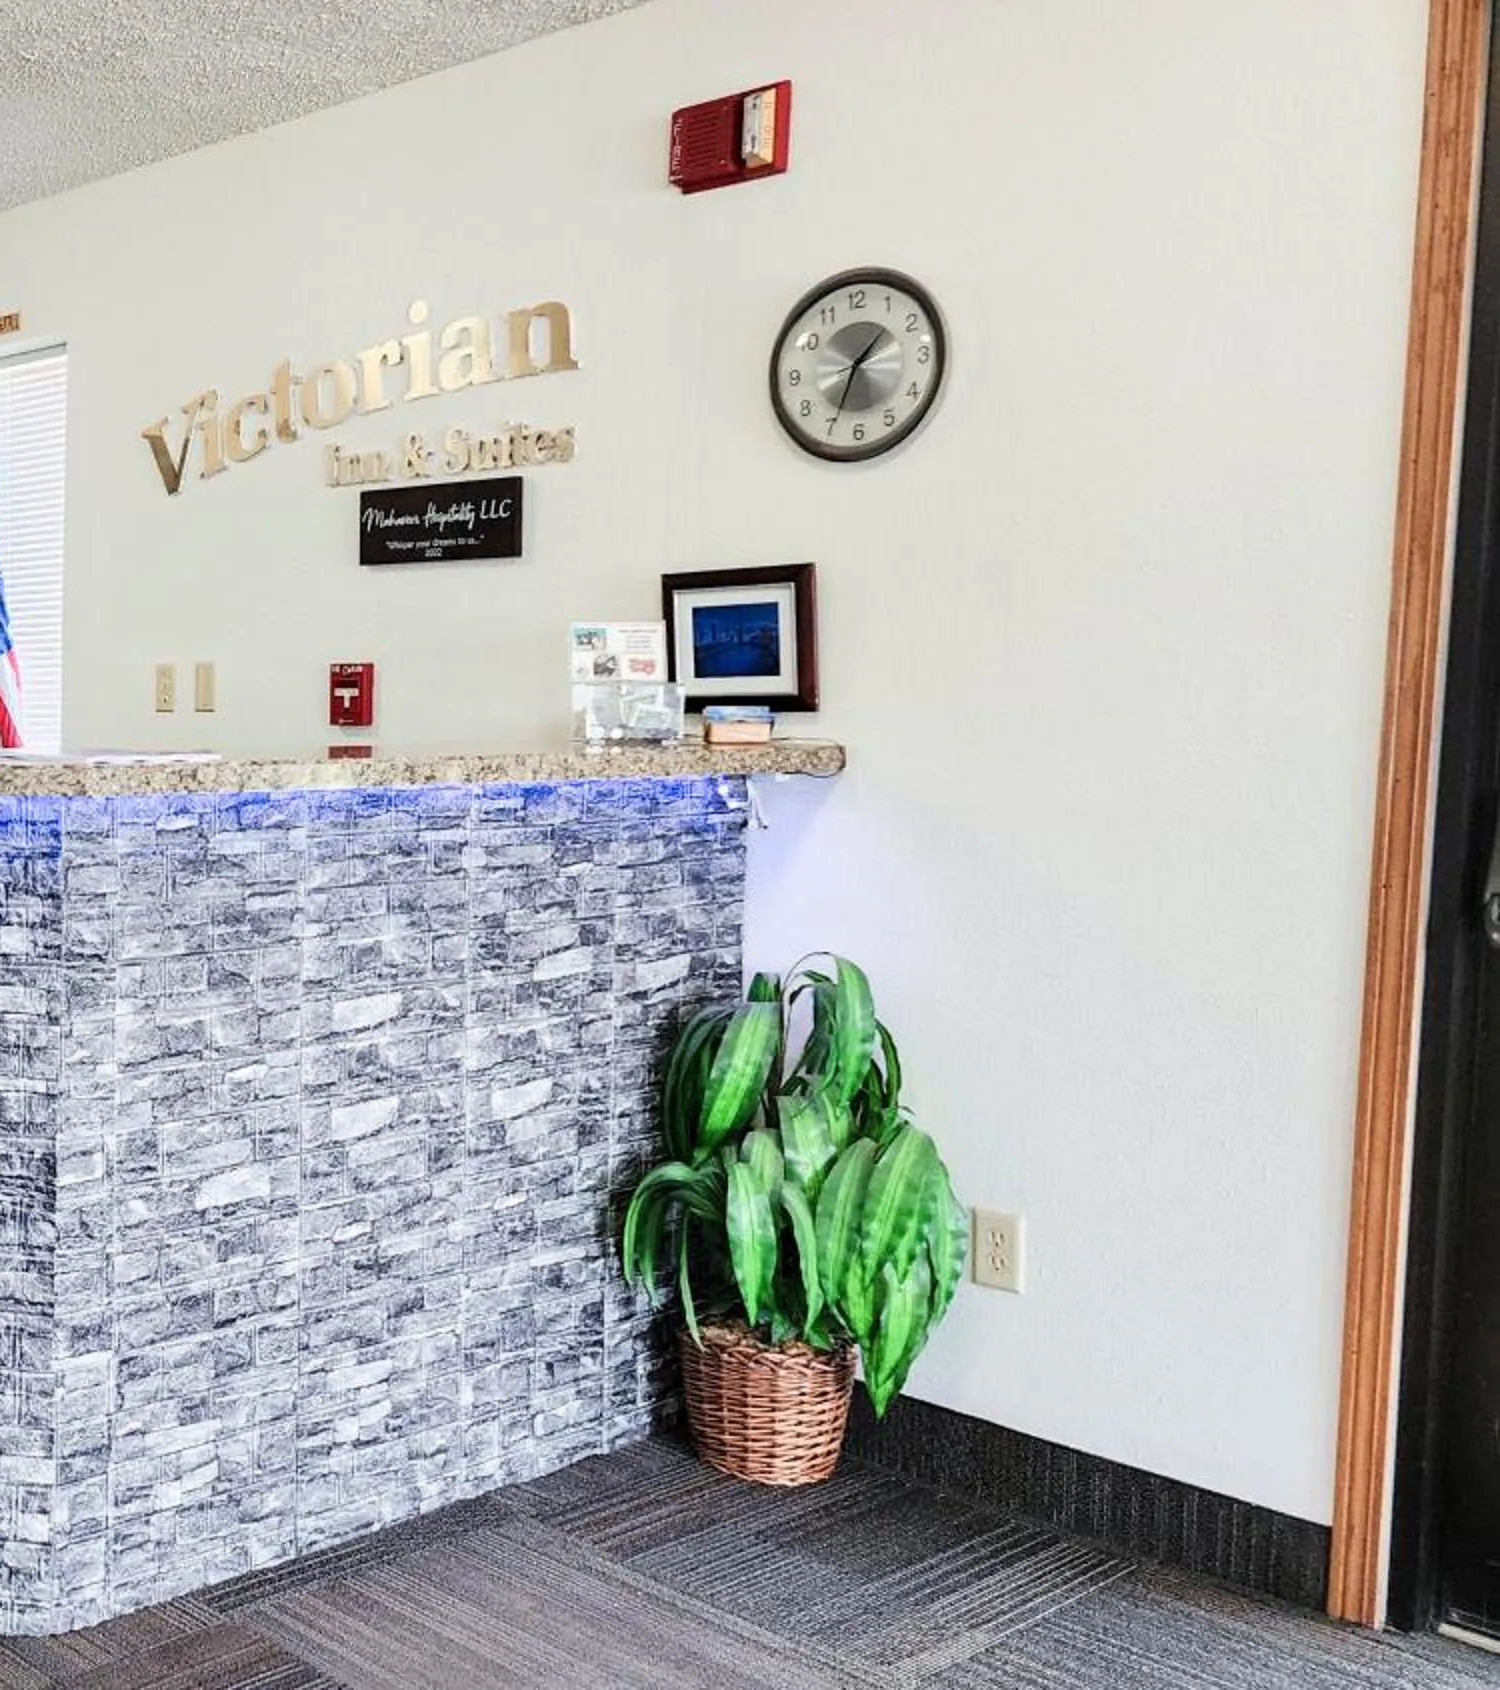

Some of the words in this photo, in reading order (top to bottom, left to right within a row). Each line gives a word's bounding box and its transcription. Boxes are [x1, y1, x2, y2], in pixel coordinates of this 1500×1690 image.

[848, 290, 866, 309] 12
[820, 306, 836, 325] 11
[905, 313, 918, 333] 2
[916, 345, 930, 364] 3
[788, 369, 801, 387] 9
[141, 299, 581, 496] Victorian
[906, 381, 920, 400] 4
[799, 400, 811, 416] 8
[825, 417, 837, 435] 7
[883, 410, 895, 427] 5
[853, 424, 865, 440] 6
[404, 432, 432, 478] &
[444, 421, 577, 473] Suites
[479, 499, 512, 519] LLC
